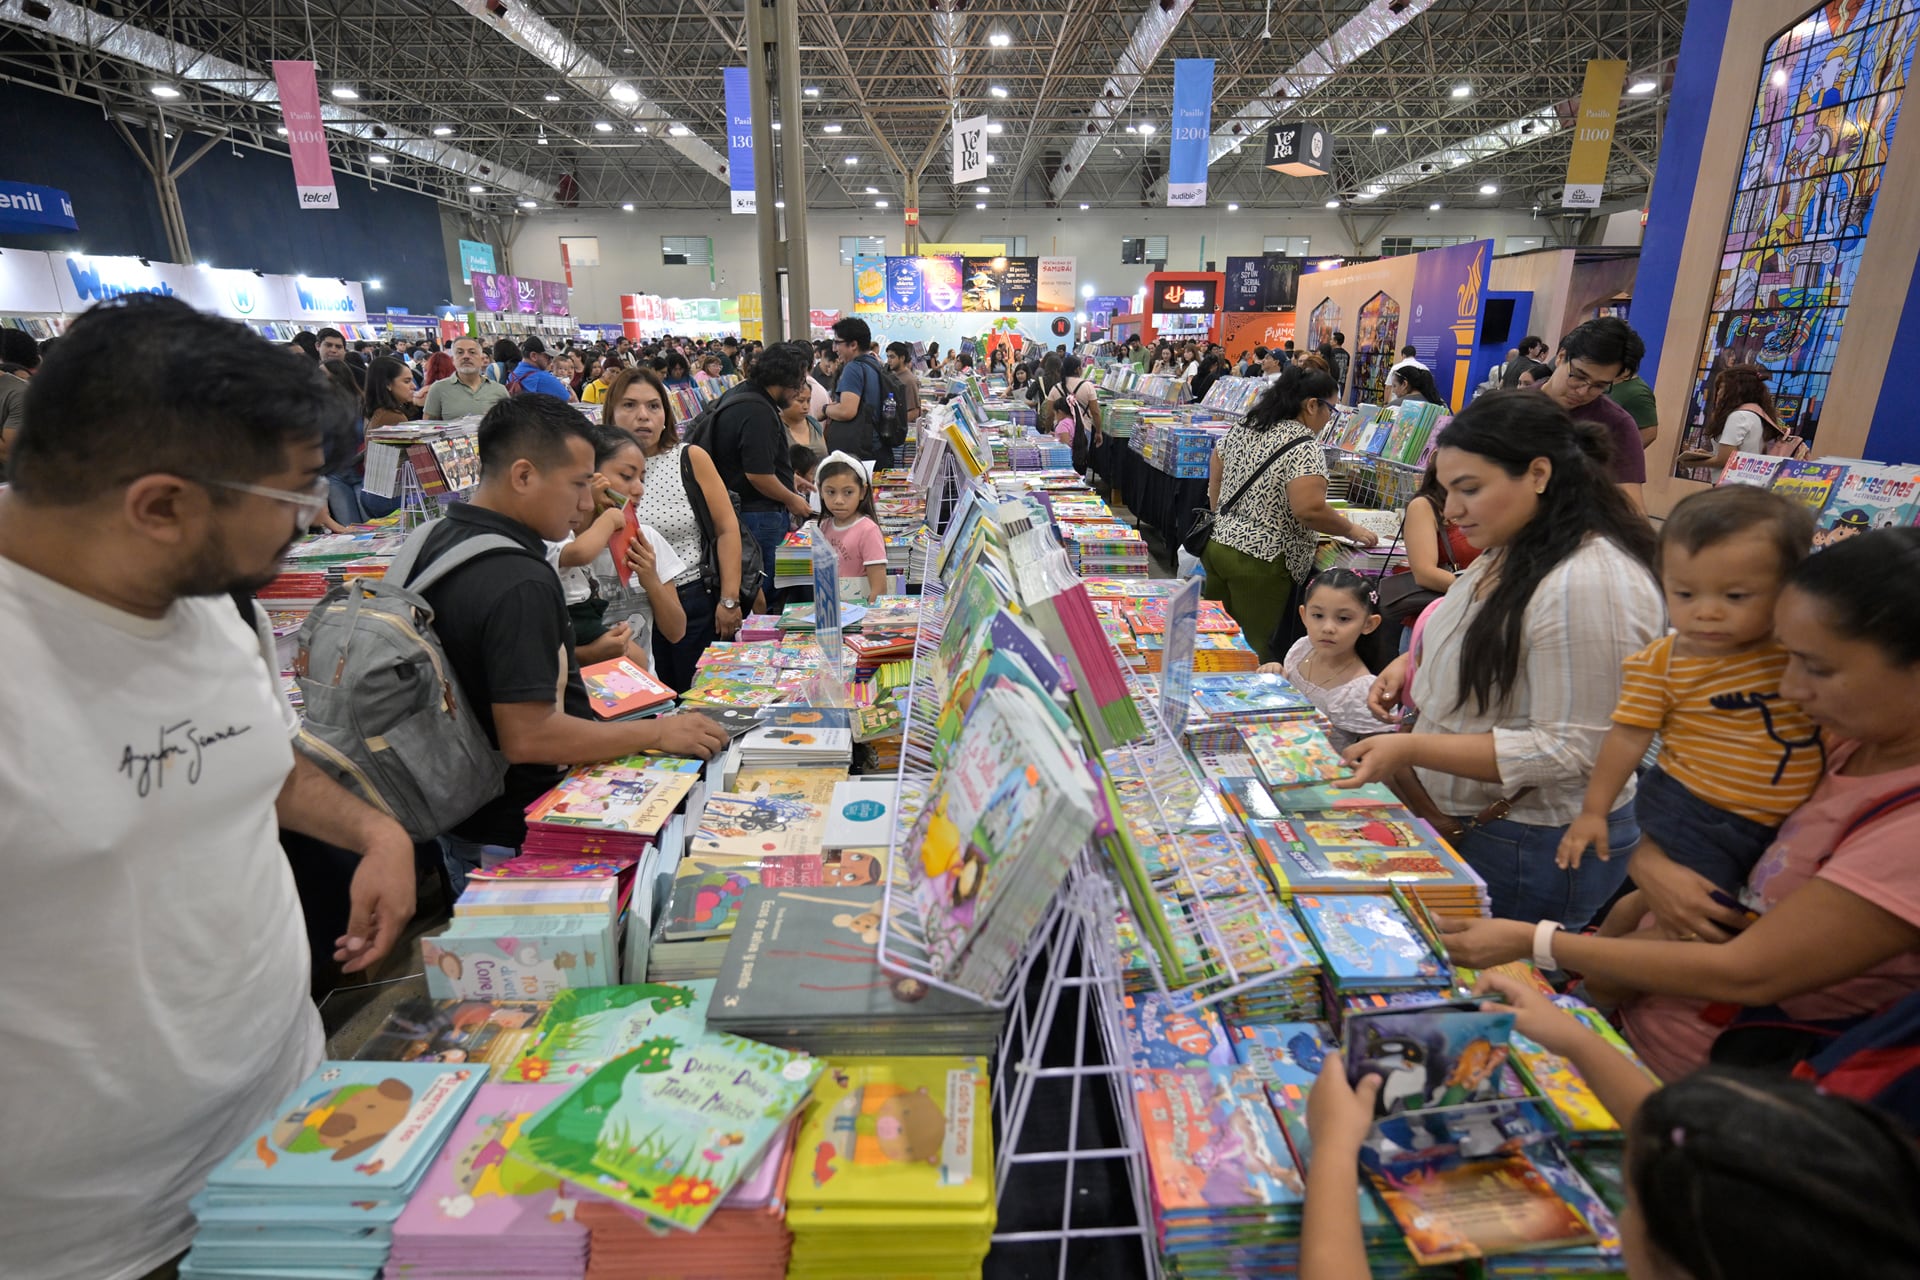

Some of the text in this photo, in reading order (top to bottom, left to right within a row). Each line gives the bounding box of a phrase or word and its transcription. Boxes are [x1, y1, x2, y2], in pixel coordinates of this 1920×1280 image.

[1180, 108, 1205, 118] Pasillo
[1586, 109, 1611, 118] Pasillo
[291, 130, 324, 145] 1400
[1175, 127, 1207, 141] 1200
[1580, 128, 1610, 142] 1100
[303, 192, 331, 203] telcel
[1170, 191, 1196, 201] audible
[1245, 261, 1254, 271] NO
[1240, 285, 1257, 293] KILLER
[295, 280, 355, 313] Winbook
[1843, 474, 1915, 498] PROFESIONES
[1854, 492, 1892, 503] ACTIVIDADES
[955, 1117, 970, 1156] Bruno
